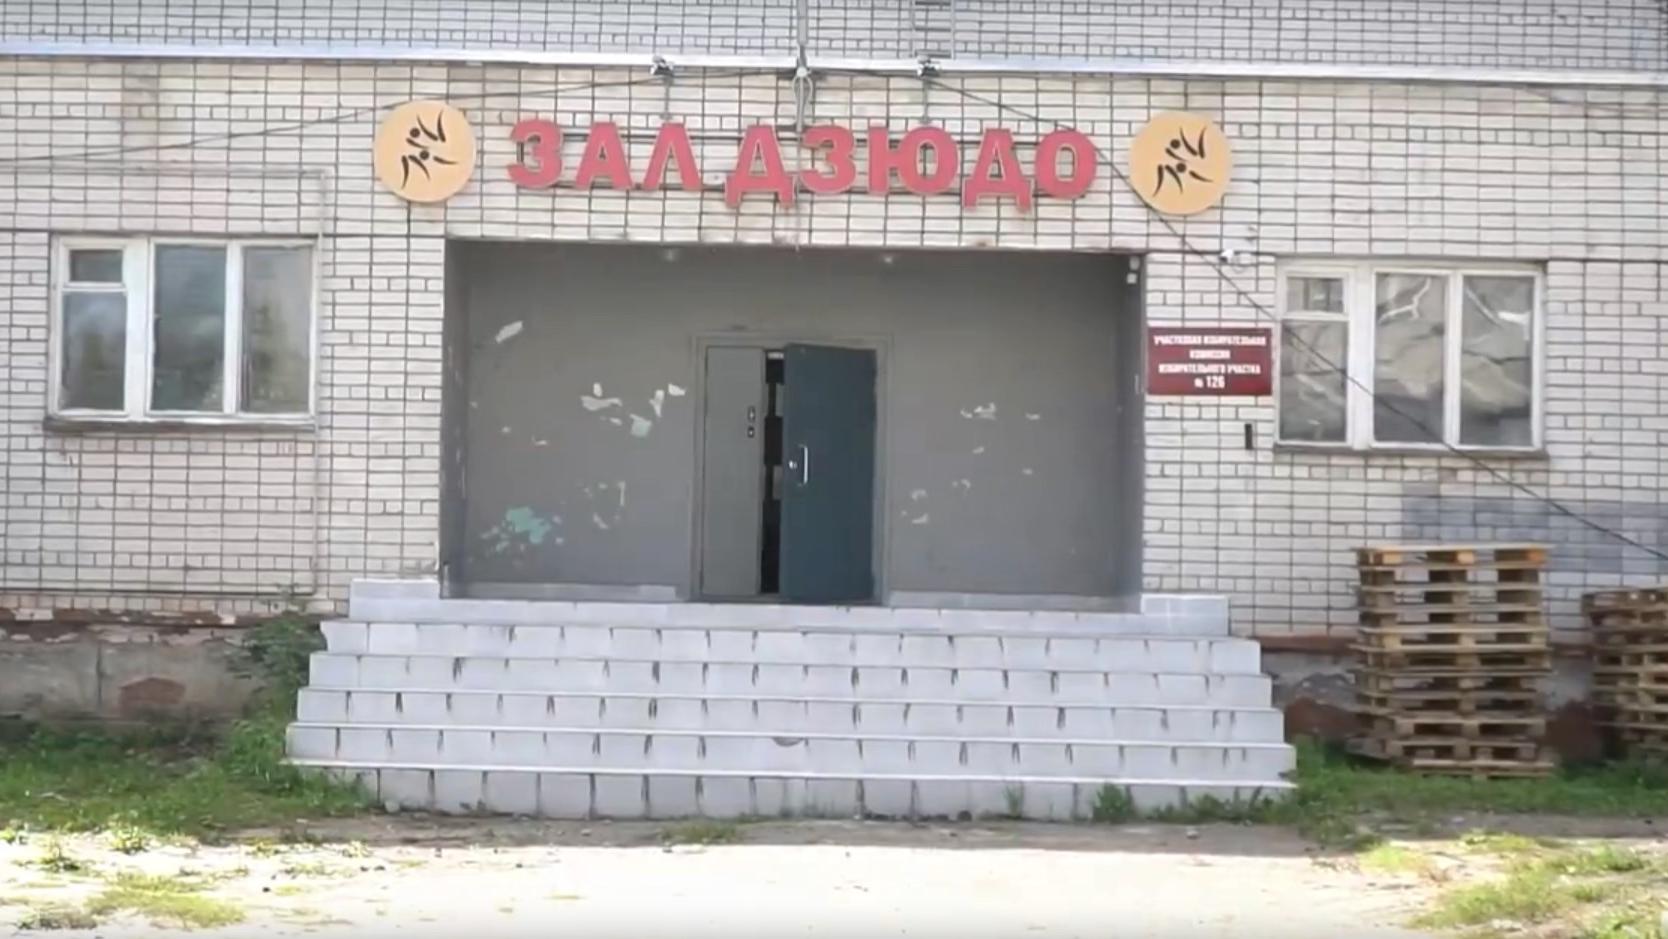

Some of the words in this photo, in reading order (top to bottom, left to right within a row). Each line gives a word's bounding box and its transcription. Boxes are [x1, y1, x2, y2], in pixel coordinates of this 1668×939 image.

[508, 119, 702, 190] ЗАЛ
[725, 124, 1097, 212] ДЗЮДО
[1206, 375, 1225, 388] 126
